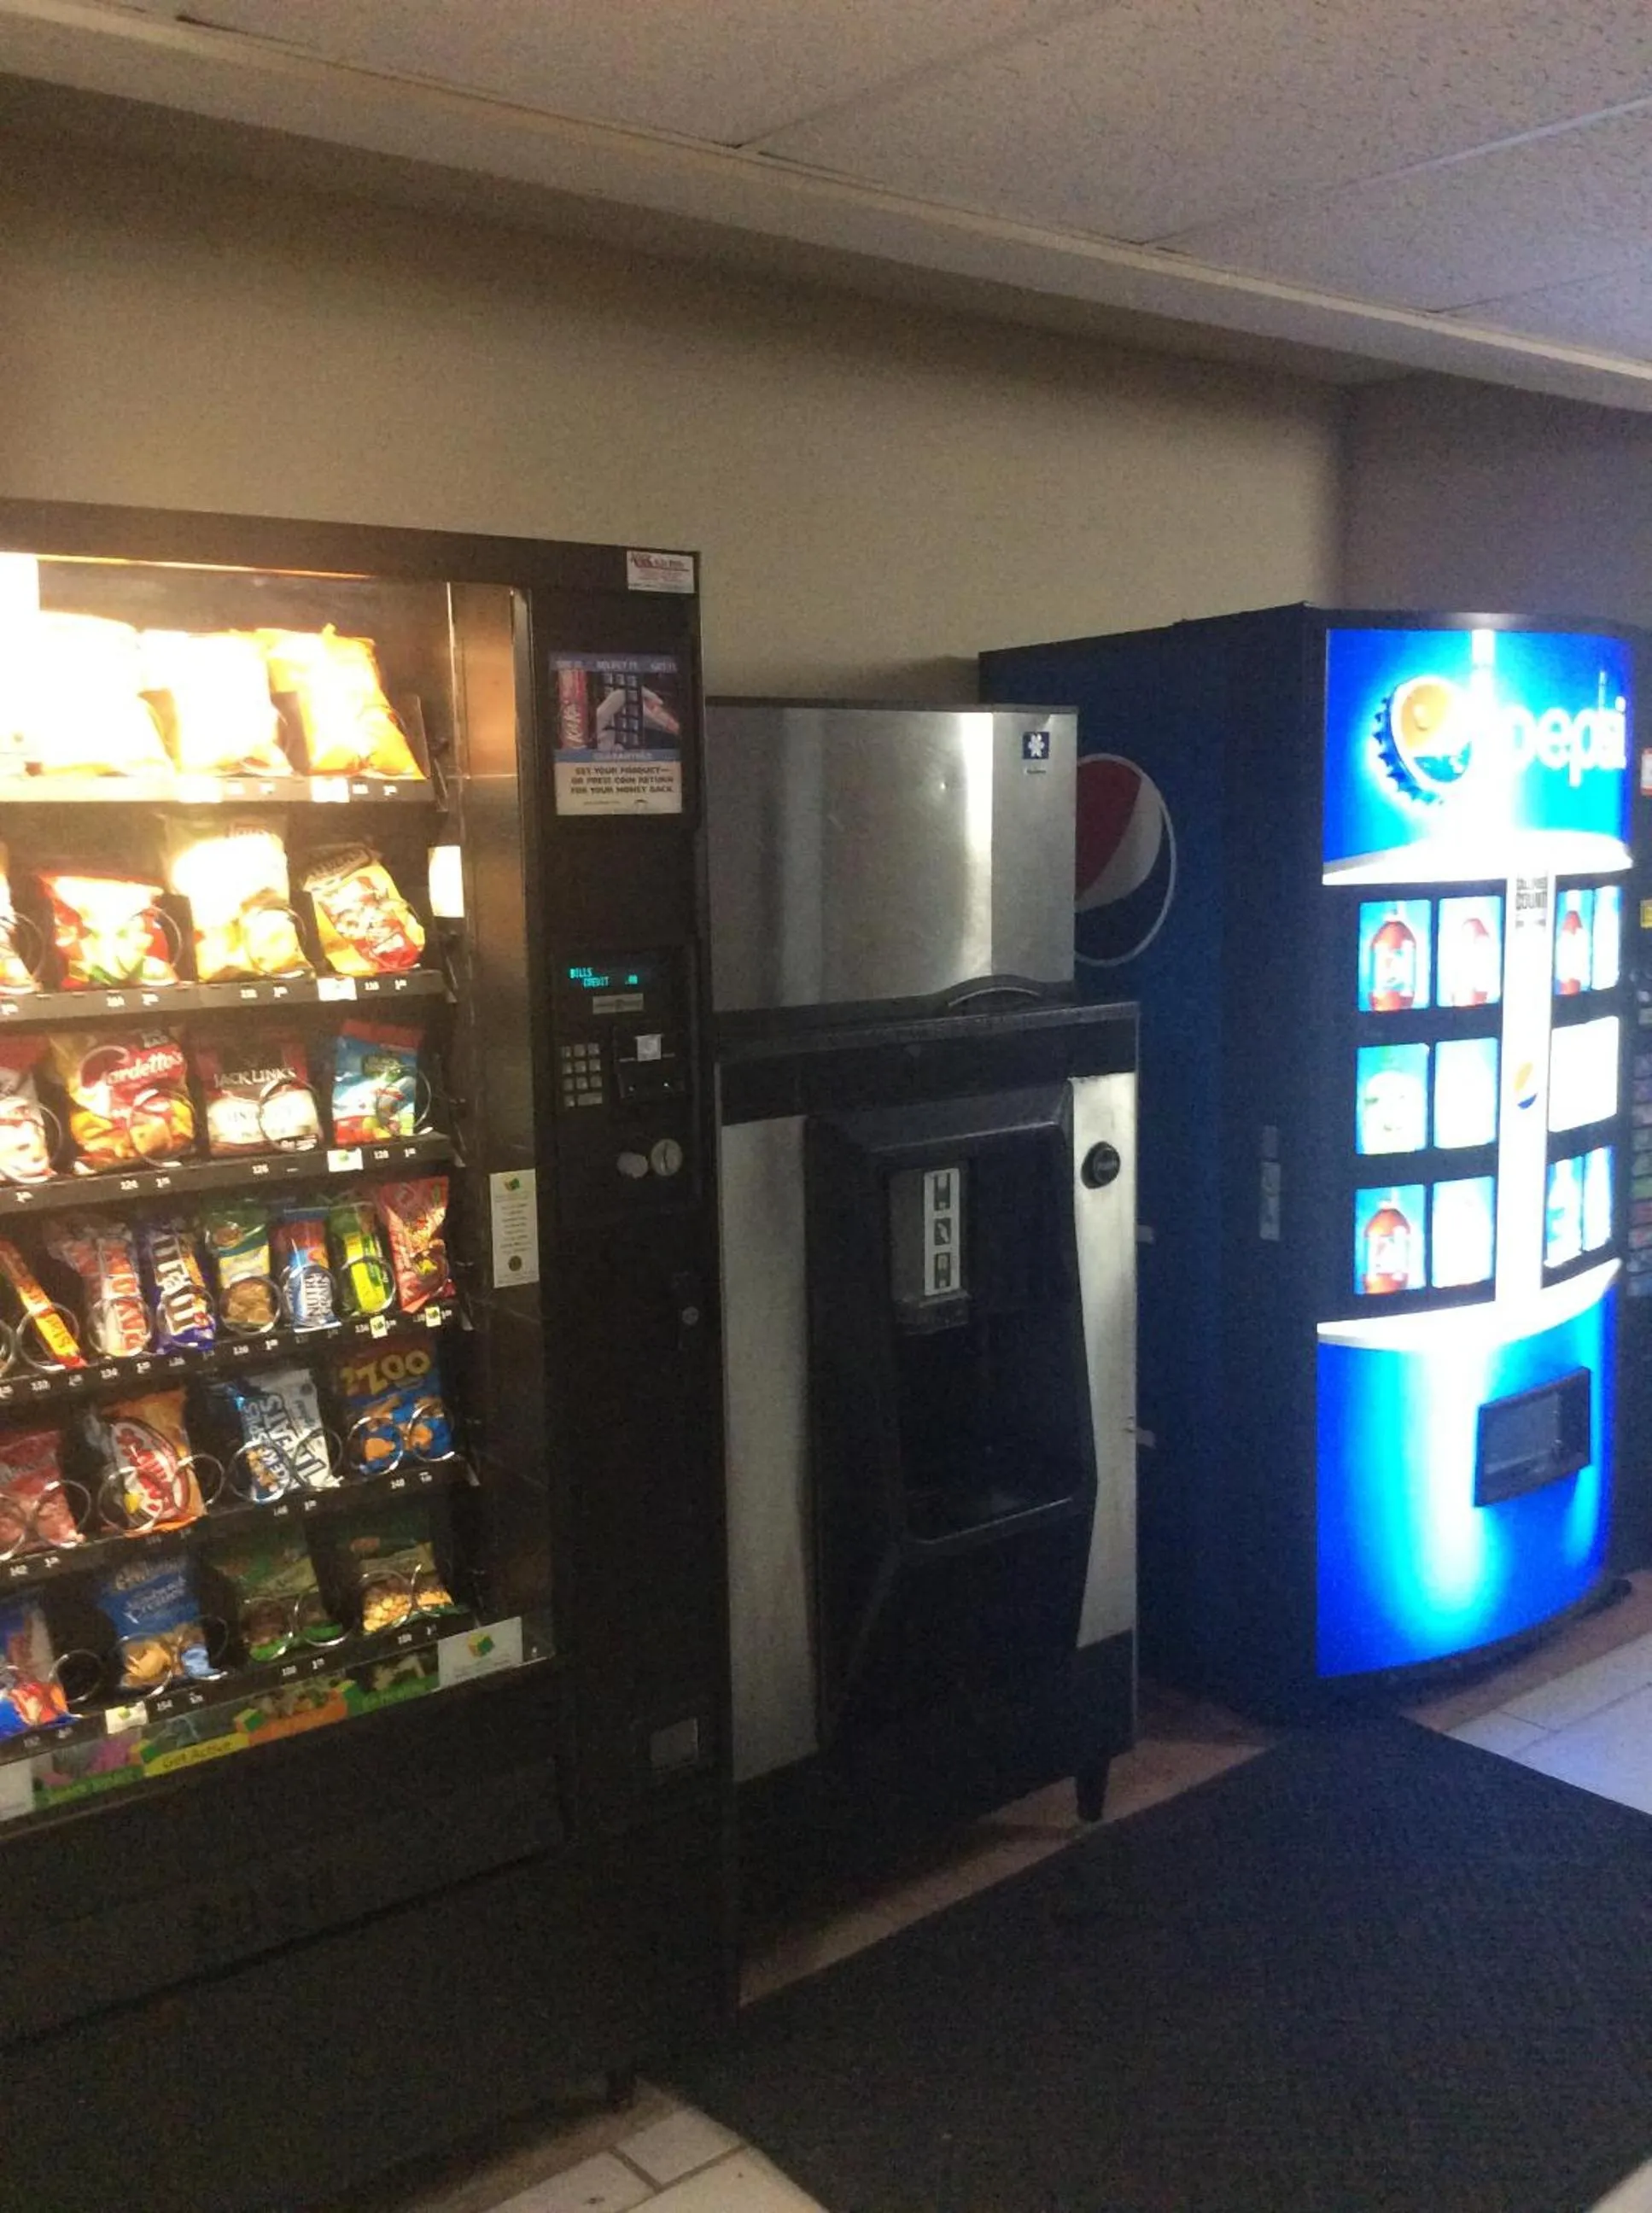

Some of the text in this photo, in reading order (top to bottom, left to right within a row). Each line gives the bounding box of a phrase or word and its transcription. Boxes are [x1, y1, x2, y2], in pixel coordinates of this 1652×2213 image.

[594, 766, 617, 774] YOUR
[590, 785, 614, 795] YOUR
[616, 785, 647, 794] MONEY
[569, 966, 593, 978] BILLS
